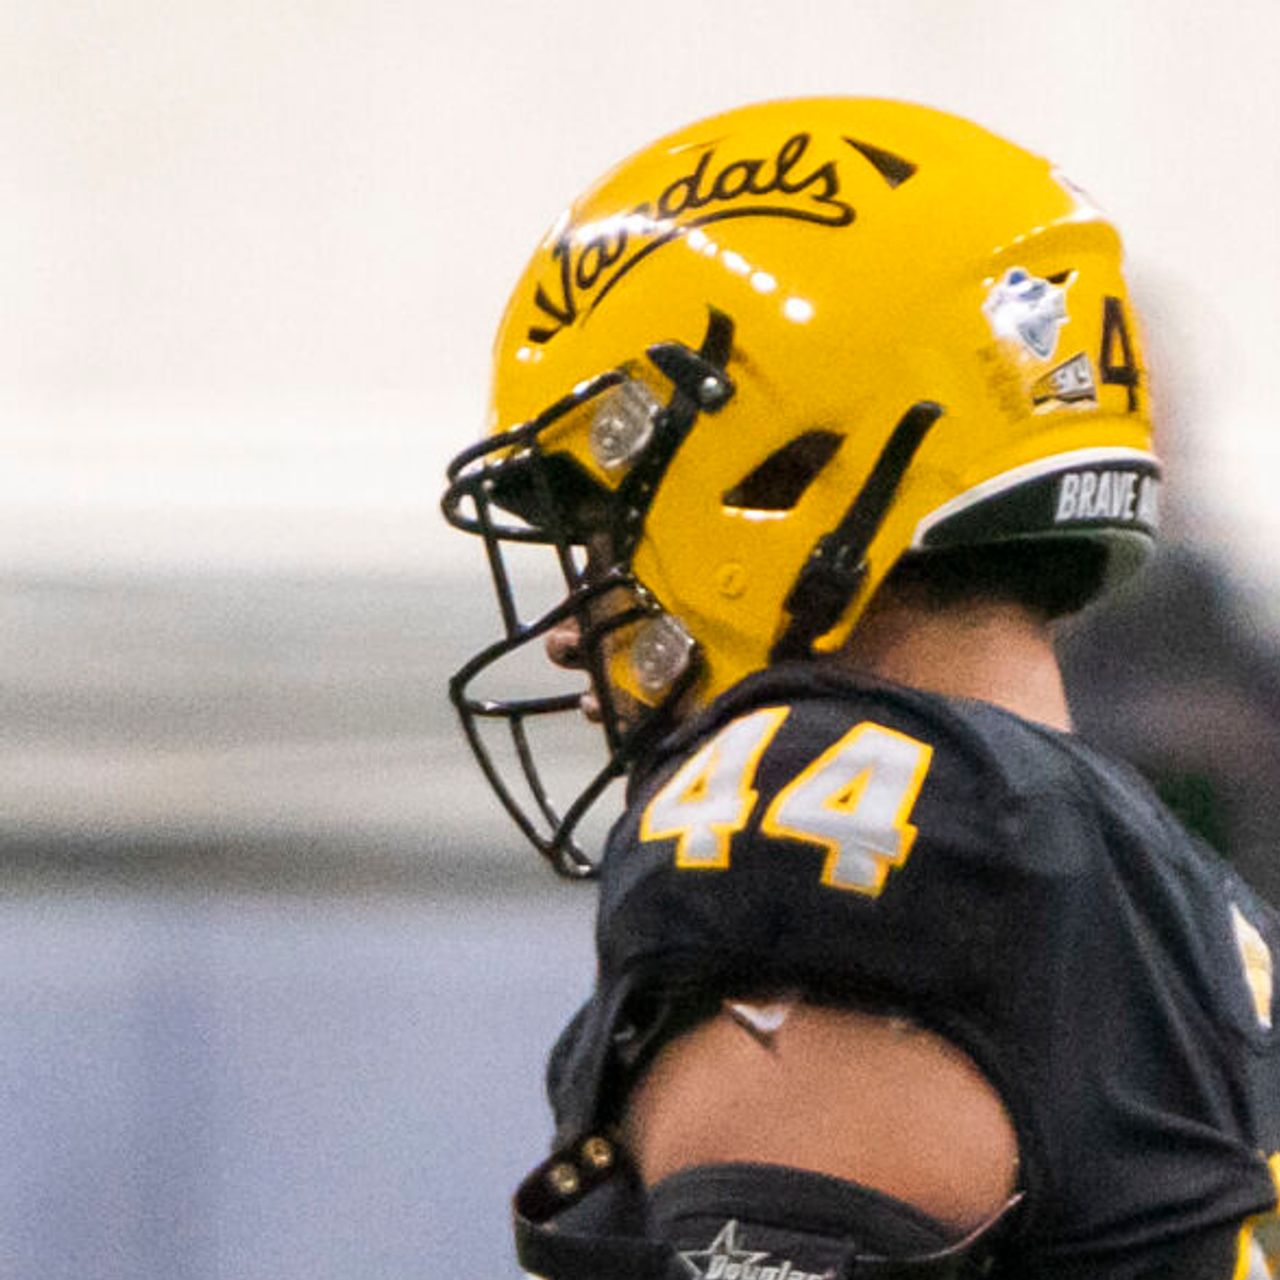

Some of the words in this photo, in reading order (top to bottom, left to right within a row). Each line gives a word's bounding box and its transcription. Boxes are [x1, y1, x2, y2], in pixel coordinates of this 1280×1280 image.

[528, 132, 854, 343] Vadals
[1055, 470, 1139, 524] BRAVE
[639, 705, 935, 899] 44
